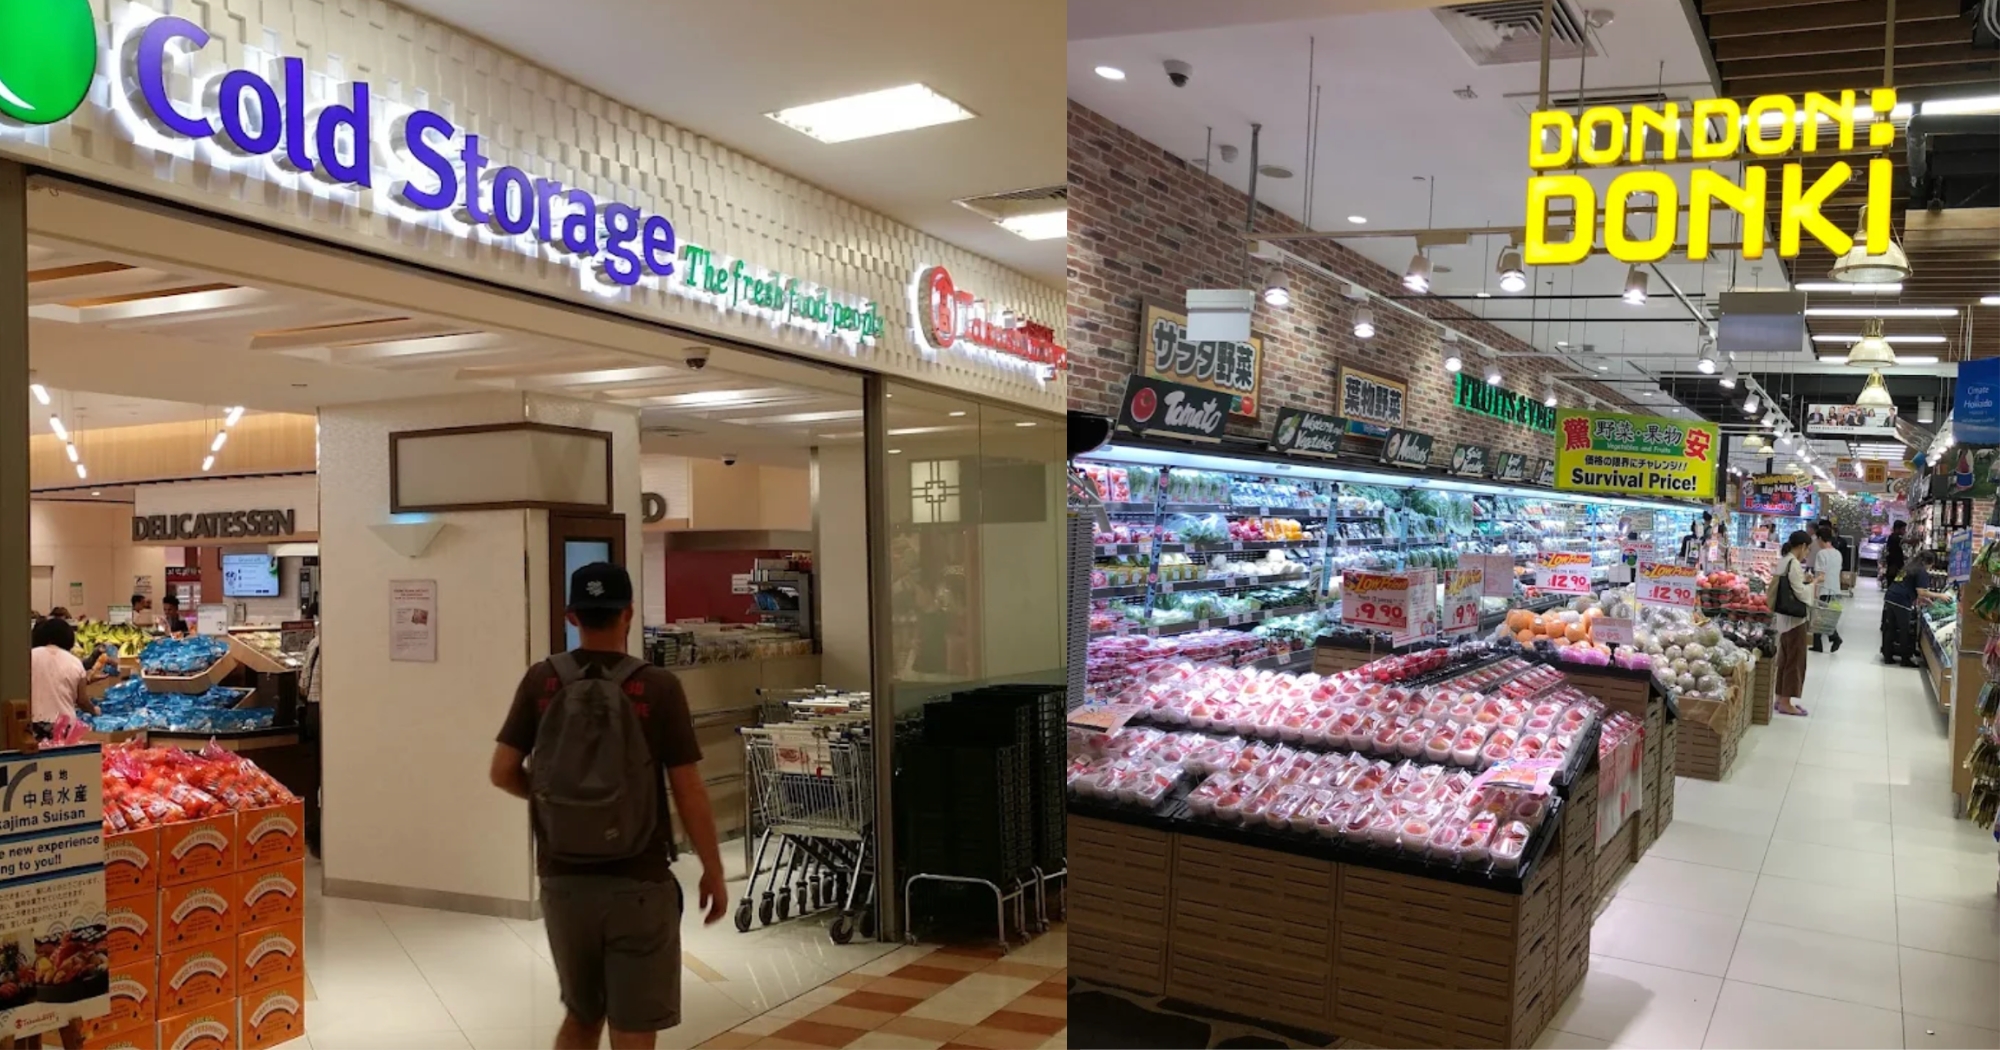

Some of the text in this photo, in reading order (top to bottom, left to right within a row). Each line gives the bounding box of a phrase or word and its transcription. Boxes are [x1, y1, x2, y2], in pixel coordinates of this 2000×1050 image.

[136, 15, 676, 286] Cold Storage
[1529, 103, 1678, 170] DON
[1525, 158, 1893, 266] DONKI
[684, 244, 885, 343] The fresh food people
[1163, 390, 1222, 434] Tomato
[1344, 374, 1402, 424] 葉物野菜
[1294, 430, 1337, 451] Vegetables
[1562, 416, 1592, 451] 驚
[1684, 427, 1711, 462] 安
[1606, 442, 1640, 452] Vegetables
[1653, 446, 1671, 454] Fruits
[1572, 468, 1644, 488] Survival
[1648, 473, 1697, 491] Price!
[132, 509, 295, 542] DELICATESSEN
[23, 784, 88, 809] 中島水産
[43, 809, 85, 824] Suisan
[9, 846, 33, 858] new
[37, 835, 100, 853] experience
[19, 861, 31, 871] to
[34, 854, 62, 871] you!!
